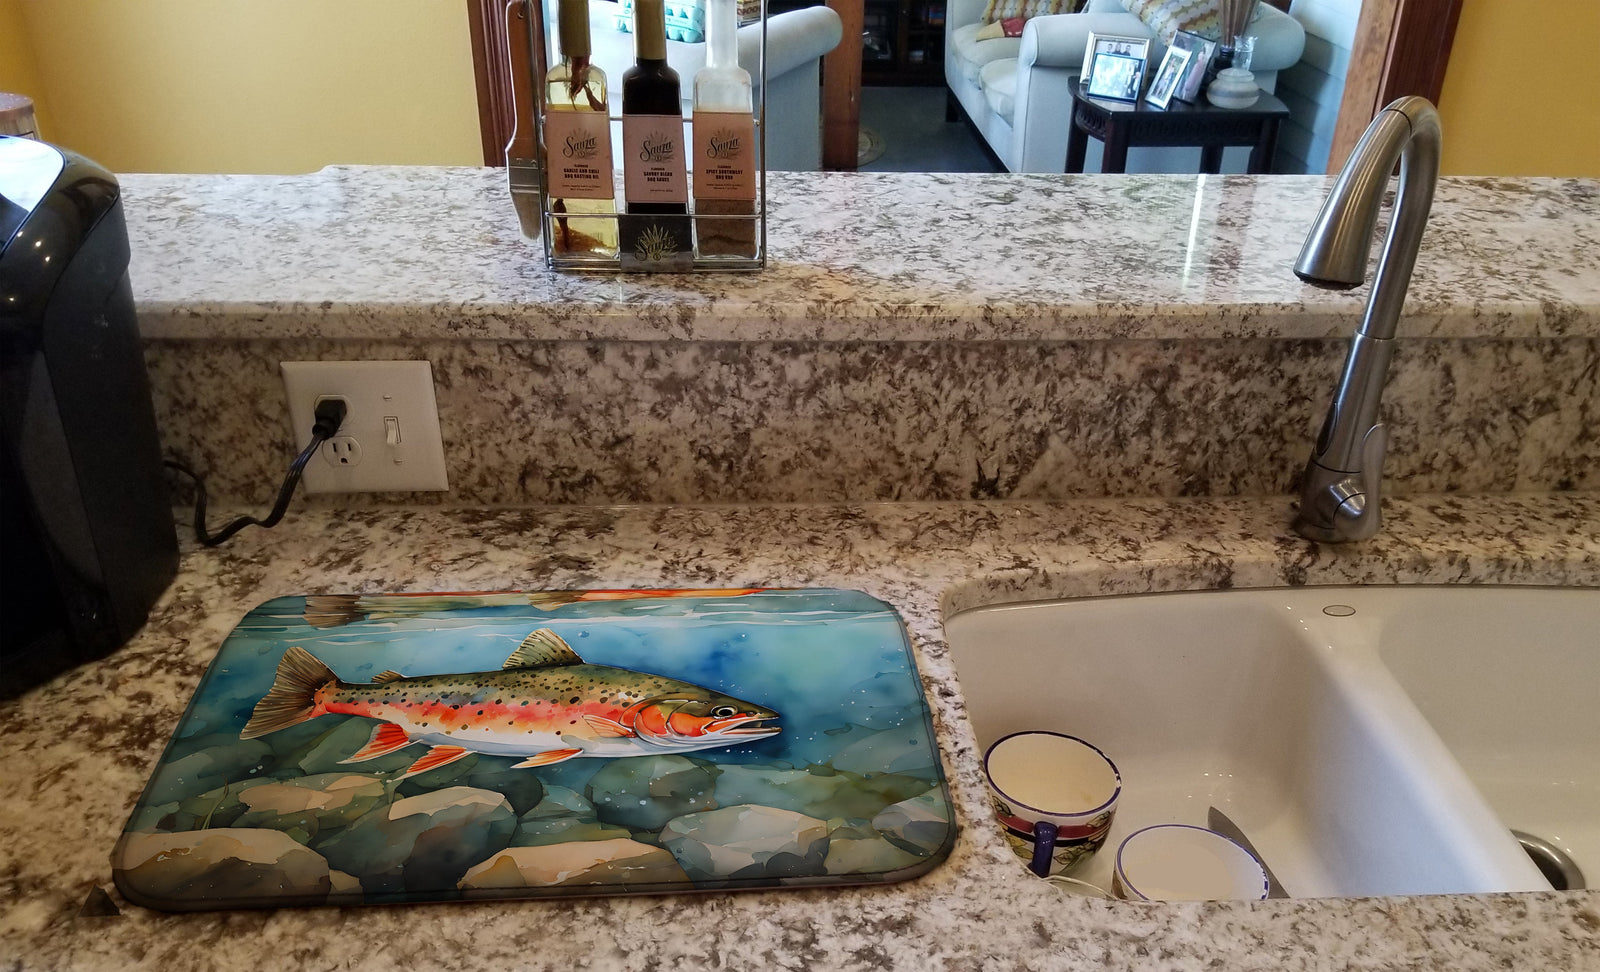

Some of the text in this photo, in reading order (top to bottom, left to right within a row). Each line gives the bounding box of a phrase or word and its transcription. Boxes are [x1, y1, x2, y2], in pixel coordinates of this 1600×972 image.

[562, 136, 598, 158] Sauza
[640, 140, 674, 161] Sauza
[706, 136, 740, 159] Sauza
